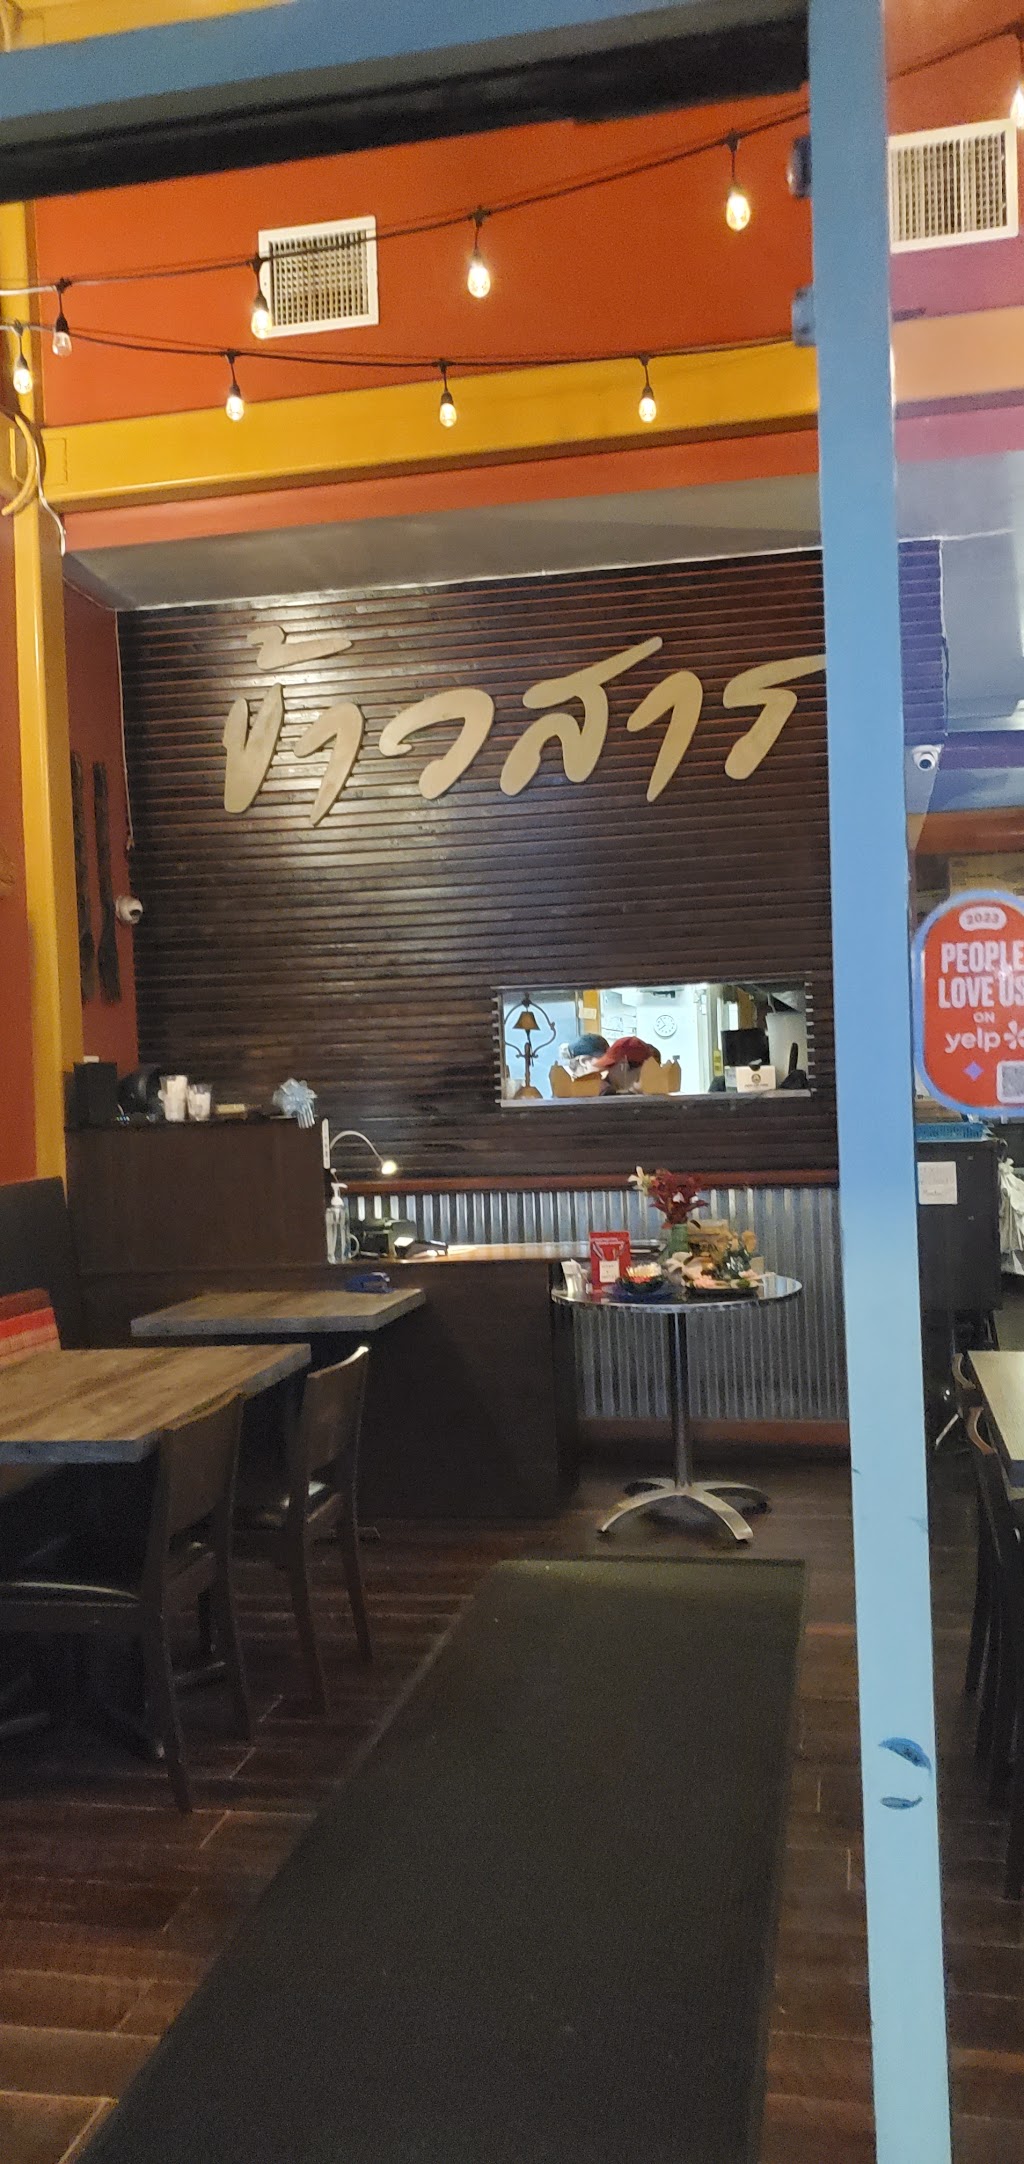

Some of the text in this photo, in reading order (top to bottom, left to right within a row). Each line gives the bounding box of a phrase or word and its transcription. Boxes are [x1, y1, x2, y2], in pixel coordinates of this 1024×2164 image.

[222, 625, 827, 828] ข้าวสาร
[941, 940, 1024, 974] PEOPLE
[938, 976, 995, 1009] LOVE
[973, 1012, 996, 1024] ON
[944, 1027, 1001, 1054] yelp
